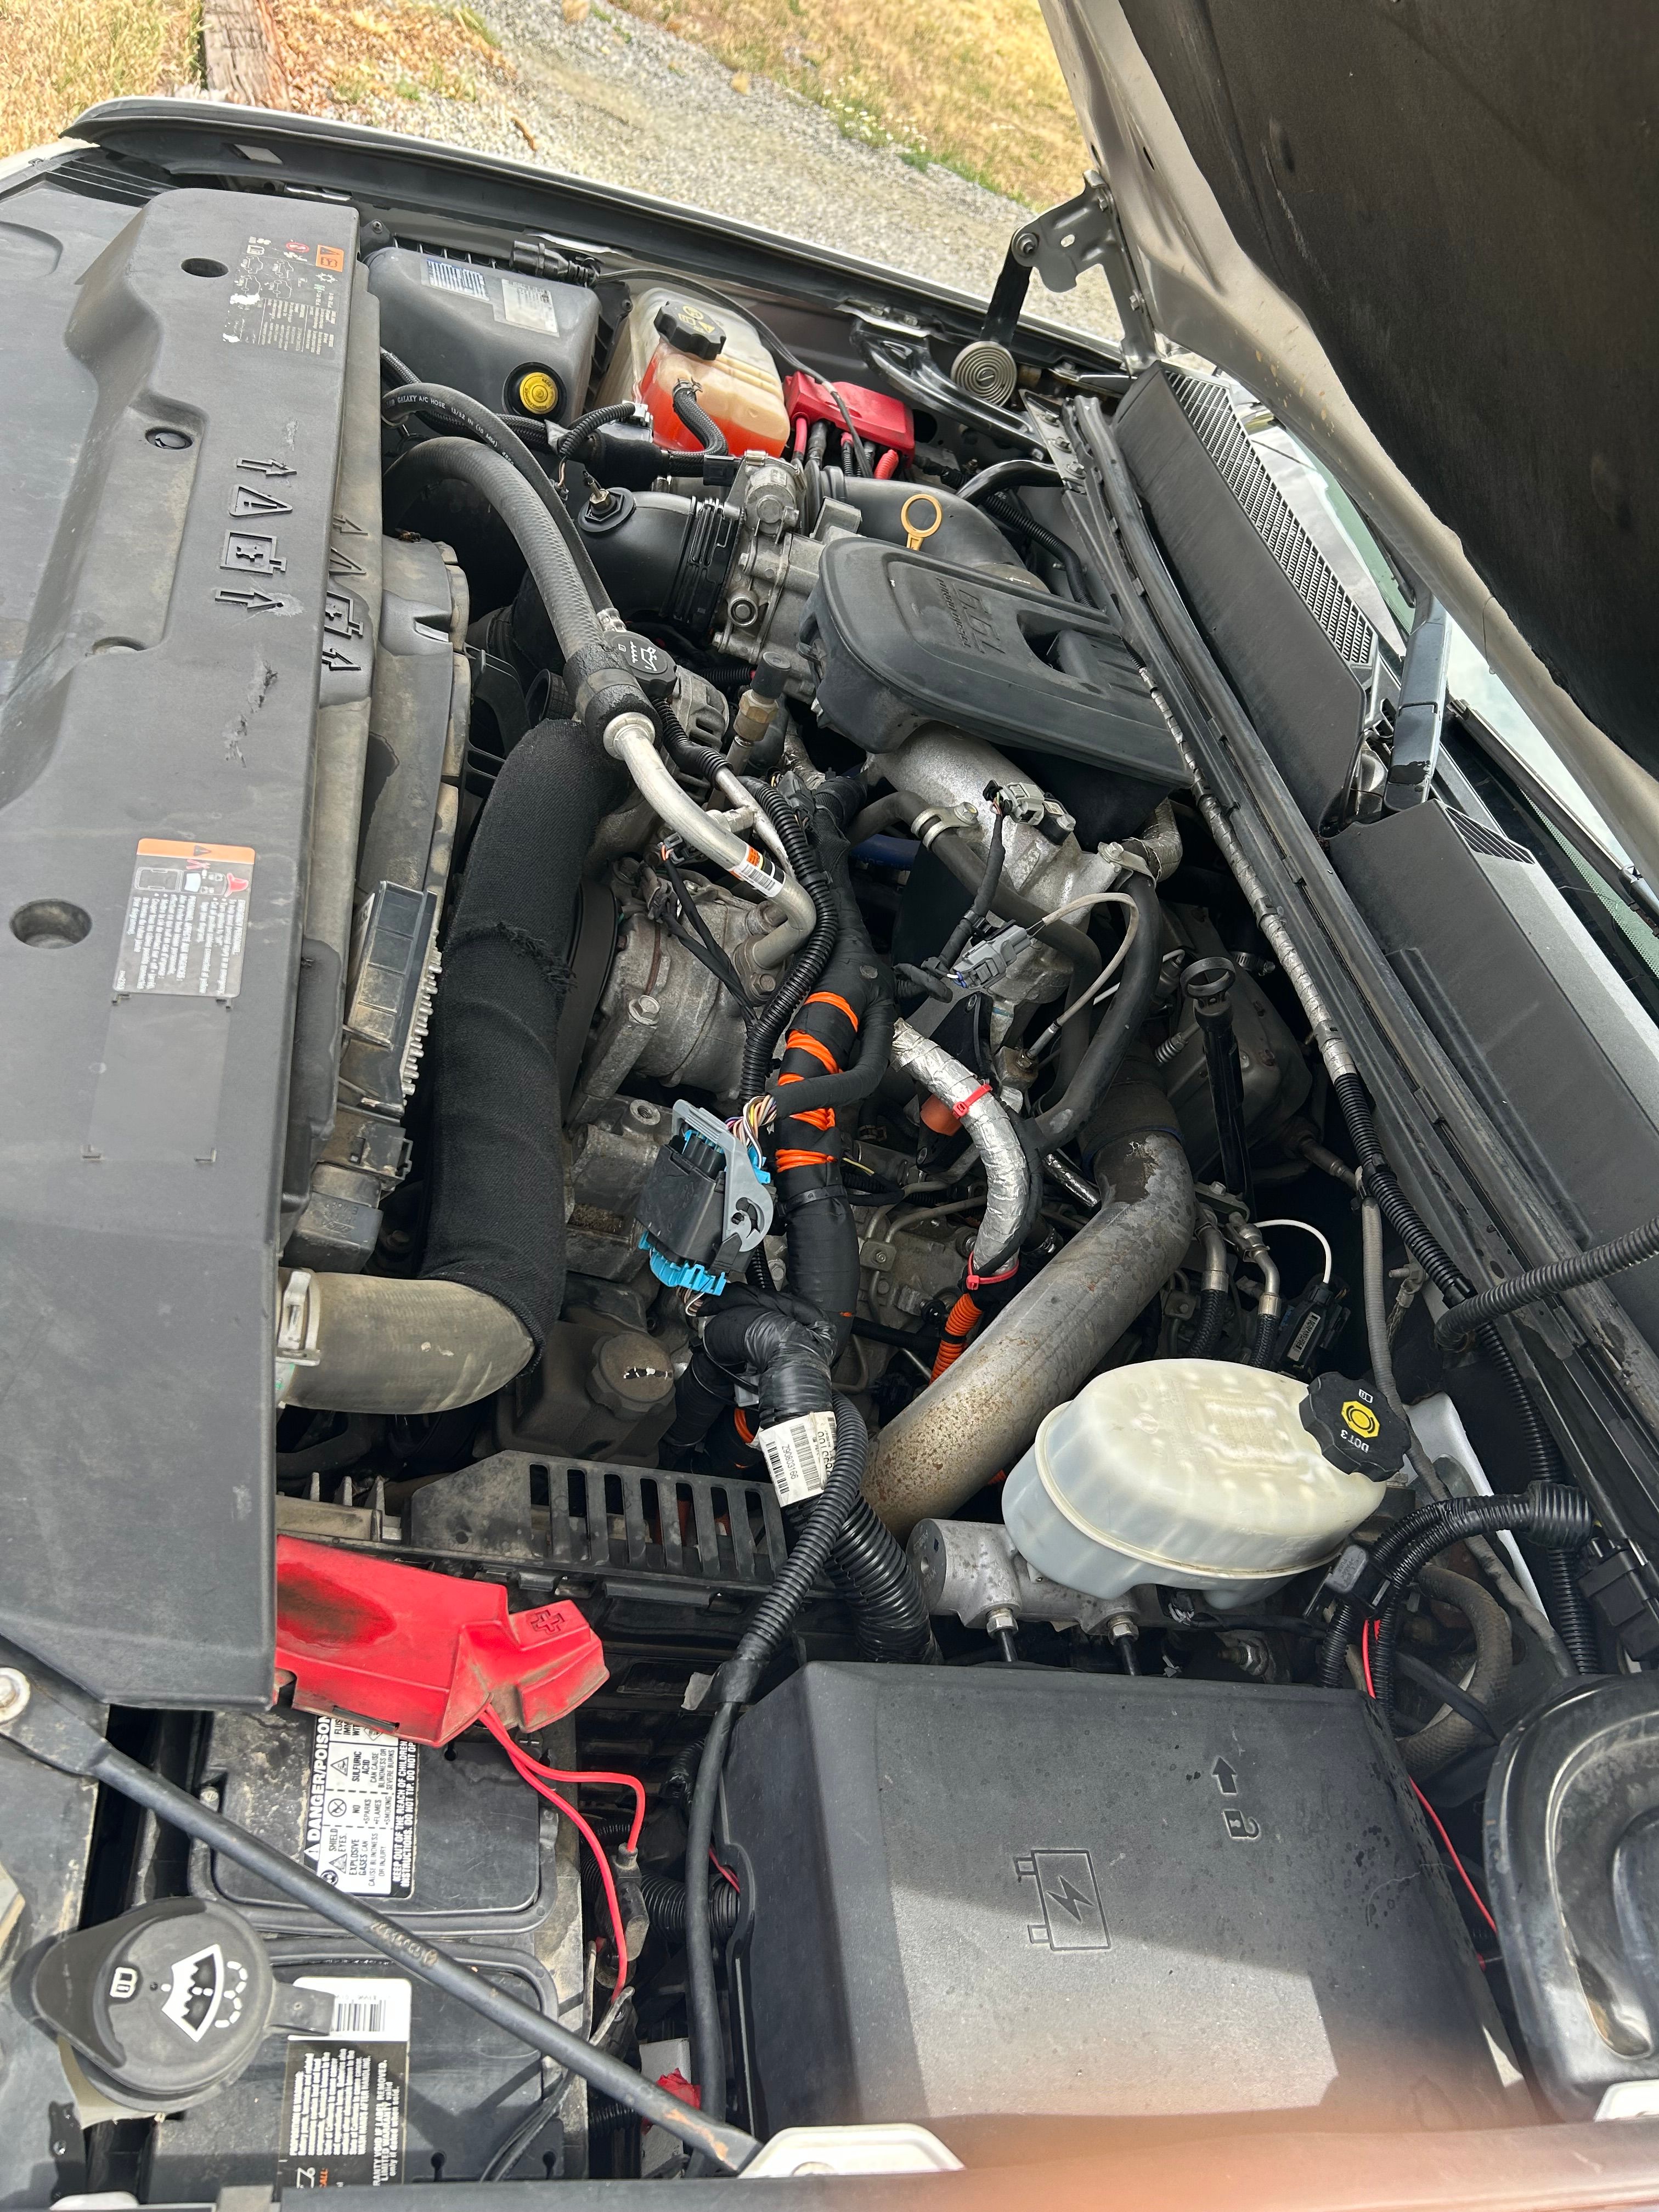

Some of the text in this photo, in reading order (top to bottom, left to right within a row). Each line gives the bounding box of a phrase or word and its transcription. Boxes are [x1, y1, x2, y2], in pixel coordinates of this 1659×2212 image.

[397, 395, 417, 403] GALAXY
[431, 399, 445, 409] HOSE
[451, 408, 465, 420] 13/32
[486, 433, 498, 447] MM)
[1340, 1429, 1369, 1453] DOT 3
[781, 1443, 799, 1480] Z90803166
[334, 1719, 343, 1734] FLUS
[351, 1751, 362, 1781] SULFURIC
[361, 1759, 370, 1774] ACID
[378, 1758, 386, 1787] BLINDNESS
[386, 1770, 394, 1790] SEVERE
[352, 1804, 360, 1813] NO
[391, 1740, 409, 1881] KEEP OUT OF THE REACH OF CHILDREN
[399, 1741, 416, 1887] INSTRUCTIONS. DO NOT TIP. DO NOT OP
[328, 1828, 338, 1851] SHIELD
[369, 1833, 378, 1864] BLINDNESS
[348, 1839, 360, 1875] EXPLOSIVE
[358, 1854, 368, 1875] GASES
[371, 2059, 387, 2186] RANTY VOID IF LABEL REMOVED.
[381, 2102, 392, 2146] WARRANTY
[380, 2147, 390, 2181] LIMITED
